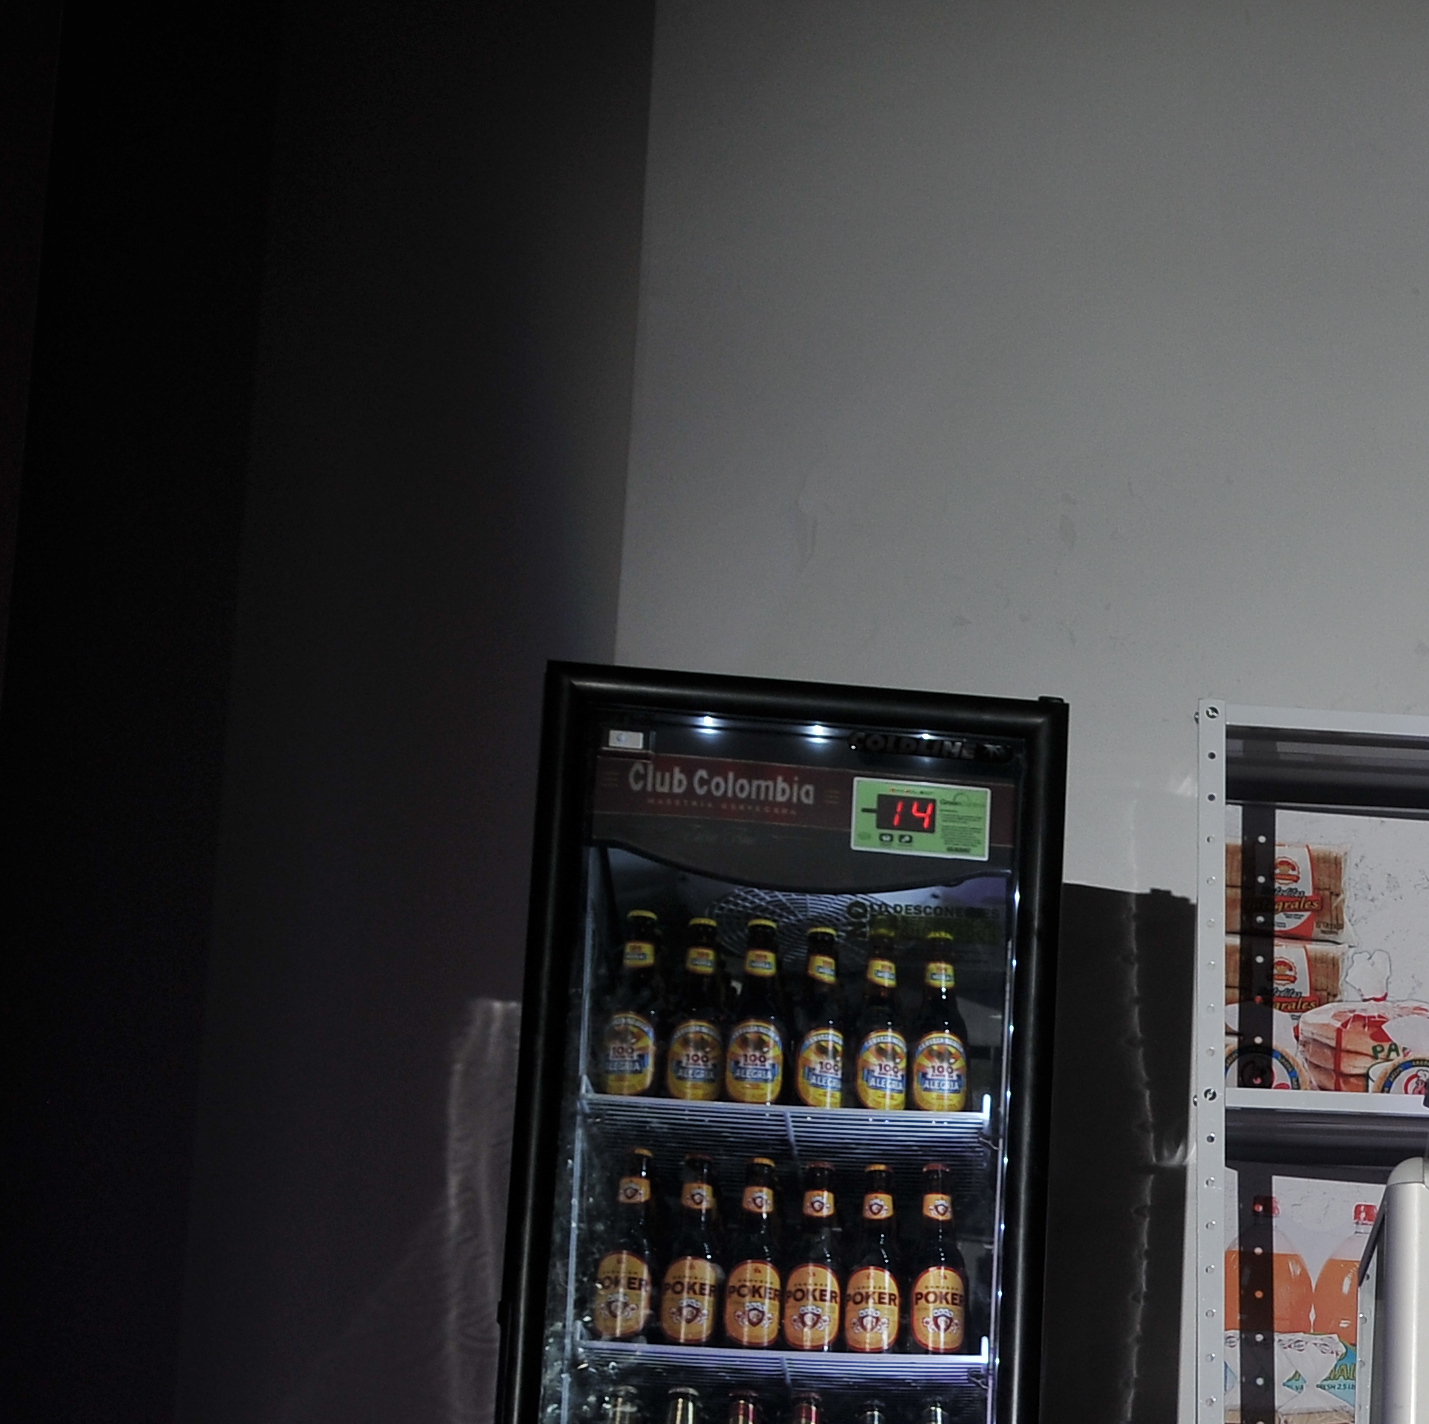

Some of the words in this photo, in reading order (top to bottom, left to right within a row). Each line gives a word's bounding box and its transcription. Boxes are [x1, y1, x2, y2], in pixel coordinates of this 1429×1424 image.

[628, 762, 687, 795] Club
[693, 765, 816, 805] Colombia
[894, 800, 934, 830] 14
[742, 1054, 767, 1063] 100
[663, 1282, 716, 1297] POKER
[785, 1289, 838, 1304] POKER
[847, 1292, 898, 1306] POKER
